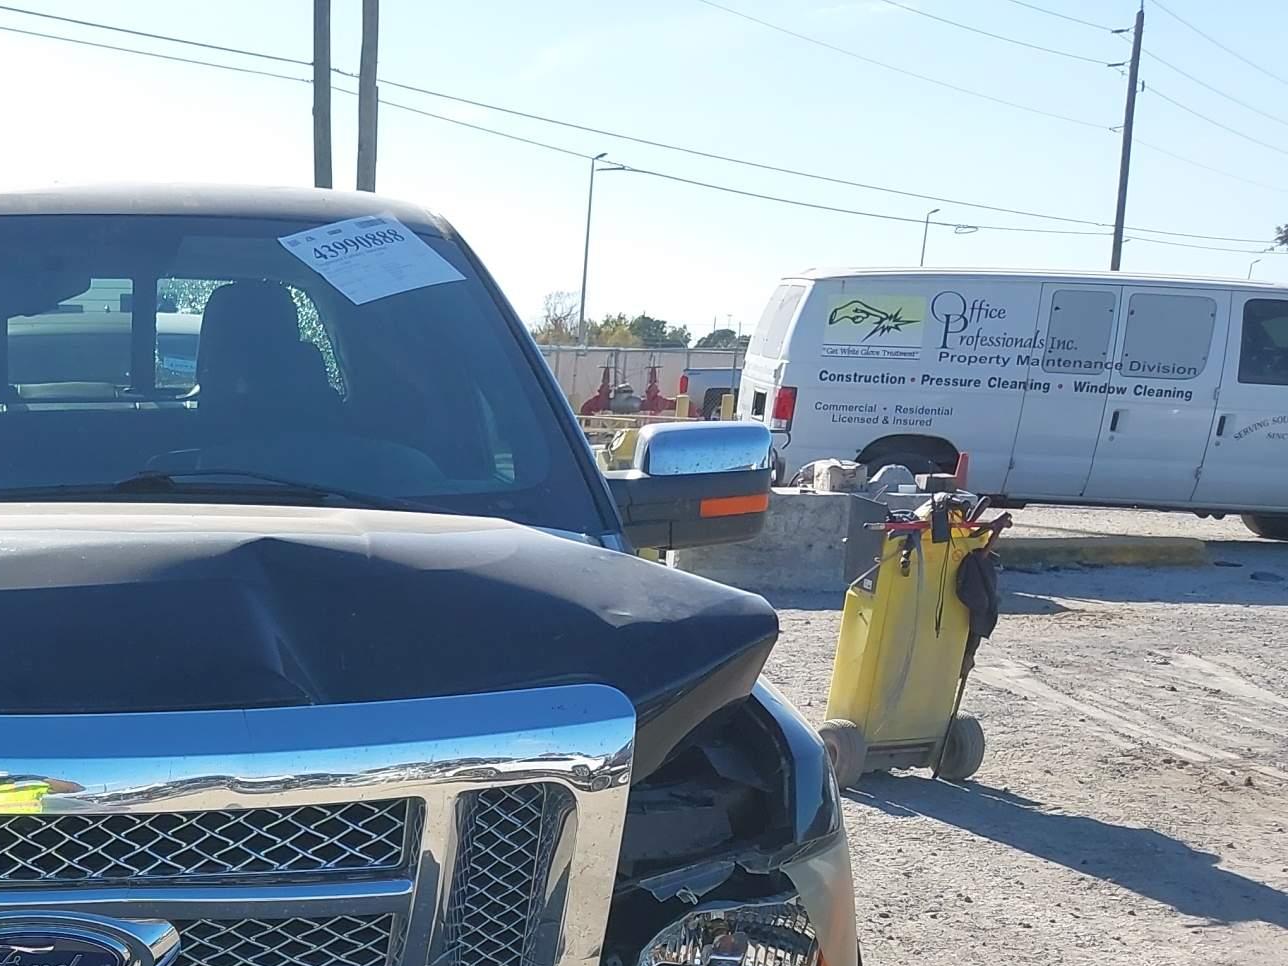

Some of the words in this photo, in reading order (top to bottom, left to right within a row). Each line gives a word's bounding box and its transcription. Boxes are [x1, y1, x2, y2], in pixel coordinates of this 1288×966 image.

[313, 228, 406, 261] 43990888
[931, 290, 1007, 324] Office
[935, 313, 1044, 352] Professionals
[1050, 336, 1078, 351] Inc.
[938, 351, 1010, 369] Property
[1016, 354, 1123, 371] Mantenance
[1129, 360, 1198, 376] Division
[818, 369, 906, 385] Construction
[920, 374, 982, 388] Pressure
[987, 376, 1051, 393] Cleaning
[1073, 380, 1127, 396] Window
[1133, 384, 1193, 401] Cleaning
[814, 401, 877, 413] Commercial
[894, 404, 953, 416] Residential
[831, 414, 879, 425] Licensed
[882, 416, 889, 425] &
[892, 417, 933, 427] Insured
